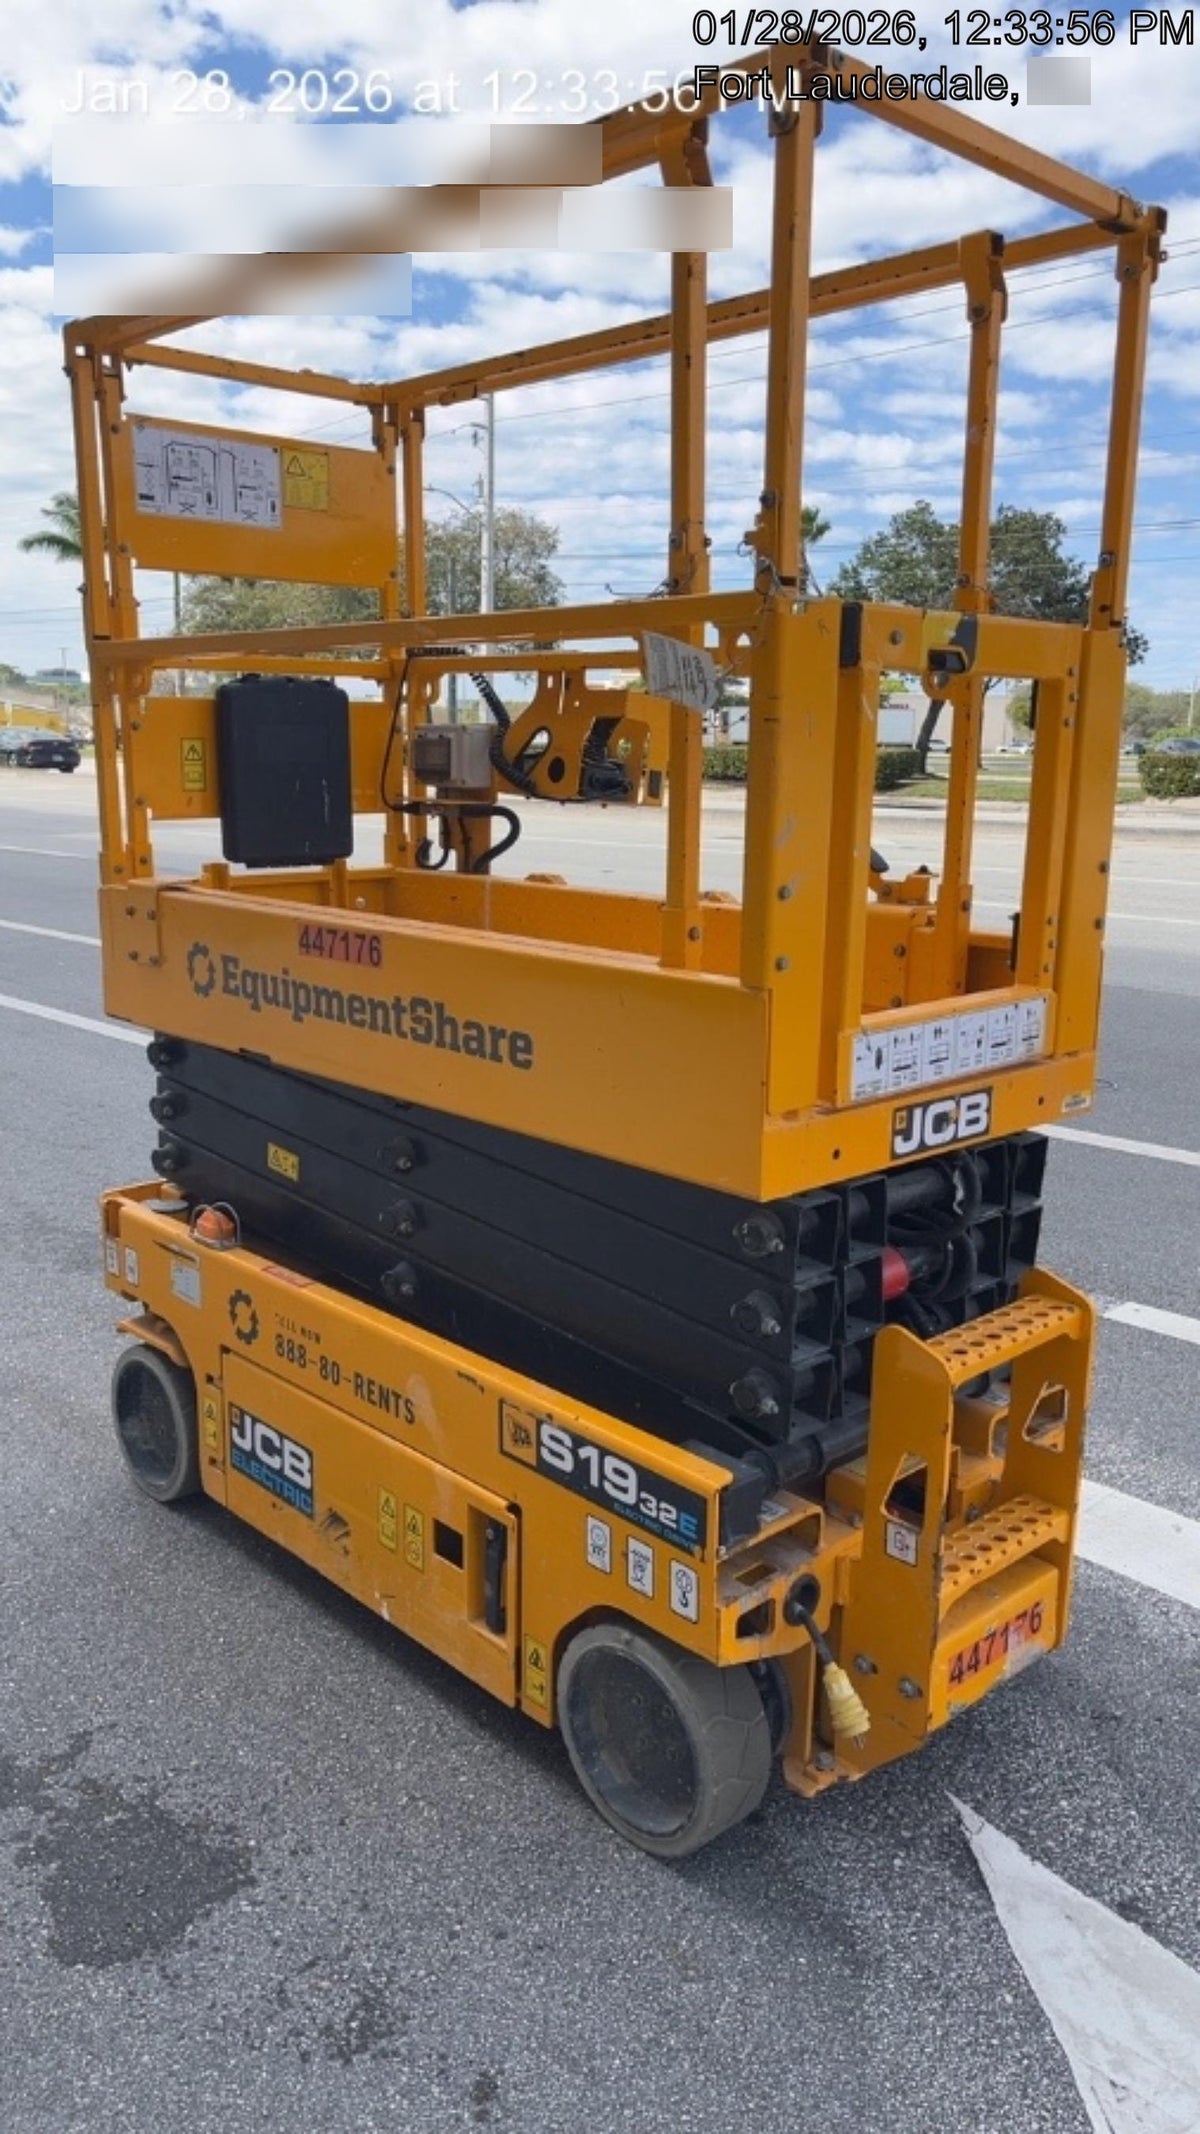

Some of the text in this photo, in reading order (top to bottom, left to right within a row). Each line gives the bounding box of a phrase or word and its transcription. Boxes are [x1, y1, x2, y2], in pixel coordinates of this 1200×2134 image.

[298, 925, 383, 968] 447176
[220, 955, 534, 1070] EquipmentShare
[893, 1091, 990, 1155] JCB
[275, 1333, 416, 1425] 888-80-RENTS
[231, 1413, 312, 1490] JCB
[231, 1447, 313, 1513] ELECTRIC
